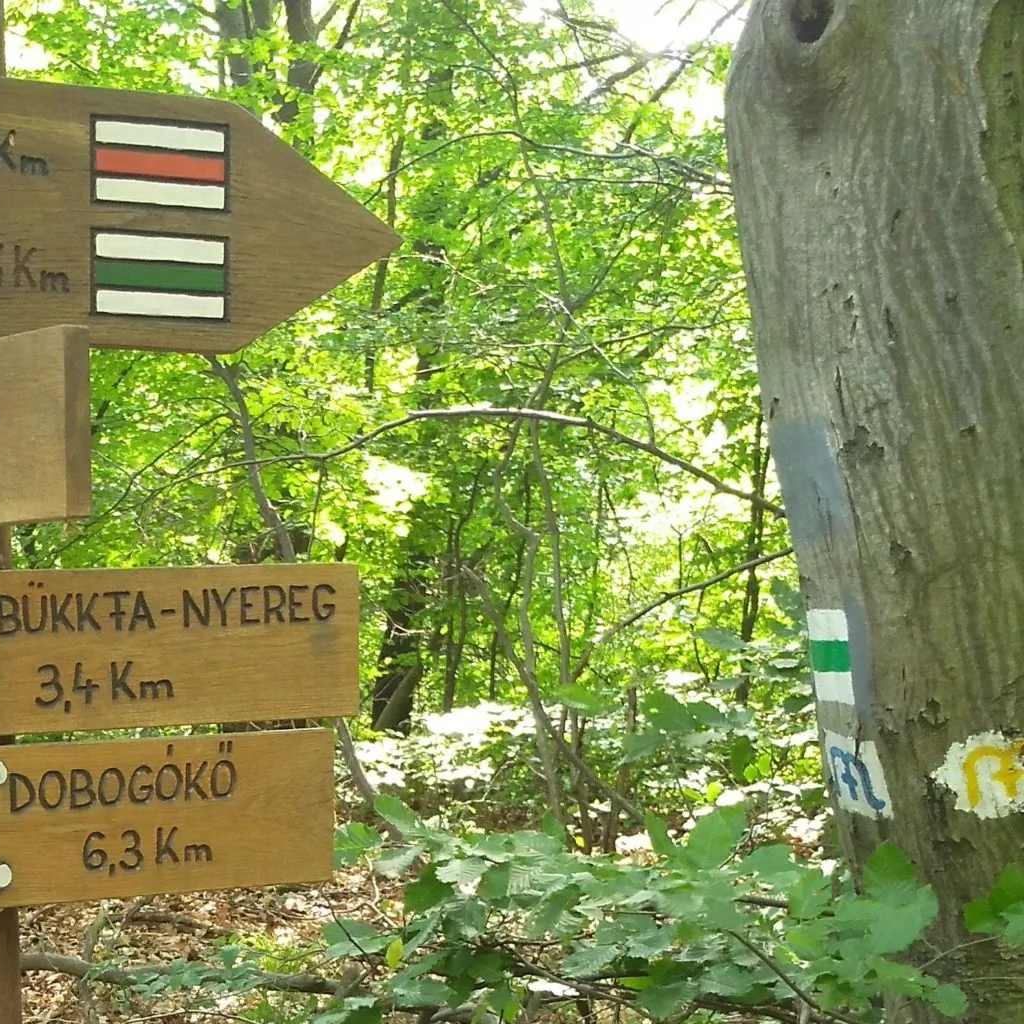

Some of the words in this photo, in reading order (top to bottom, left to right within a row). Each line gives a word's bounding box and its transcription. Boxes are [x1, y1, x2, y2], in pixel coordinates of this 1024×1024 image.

[13, 245, 71, 293] Km
[35, 661, 100, 713] 3,4
[111, 660, 174, 701] Km
[9, 741, 237, 814] DOBOGÓKŐ
[82, 829, 144, 877] 6,3
[156, 826, 213, 866] Km
